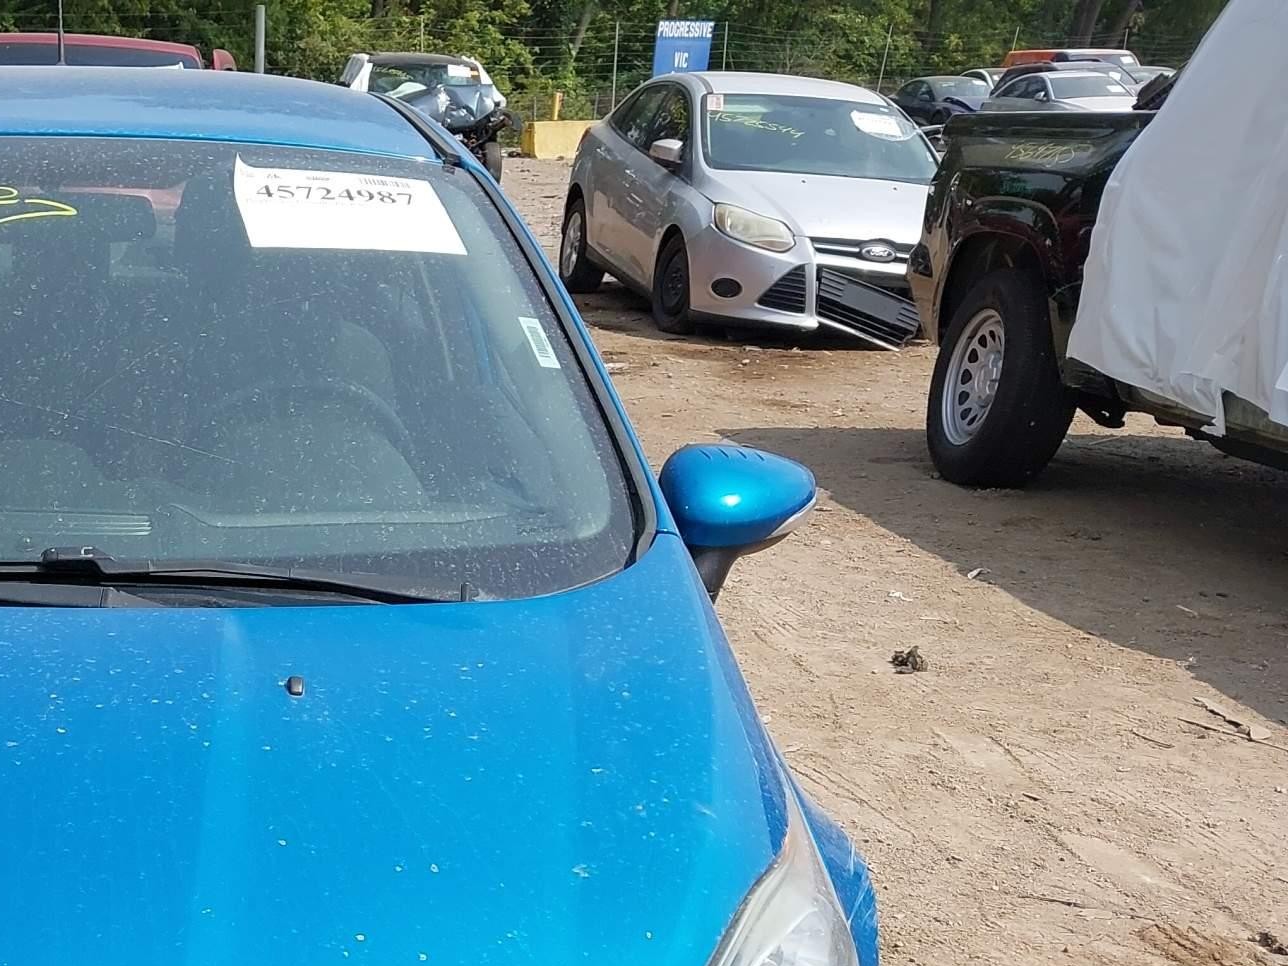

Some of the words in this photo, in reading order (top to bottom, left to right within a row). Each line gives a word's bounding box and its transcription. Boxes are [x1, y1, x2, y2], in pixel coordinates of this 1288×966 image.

[657, 20, 715, 38] PROGRESSIVE
[674, 51, 689, 68] VIC
[255, 183, 413, 206] 45724987
